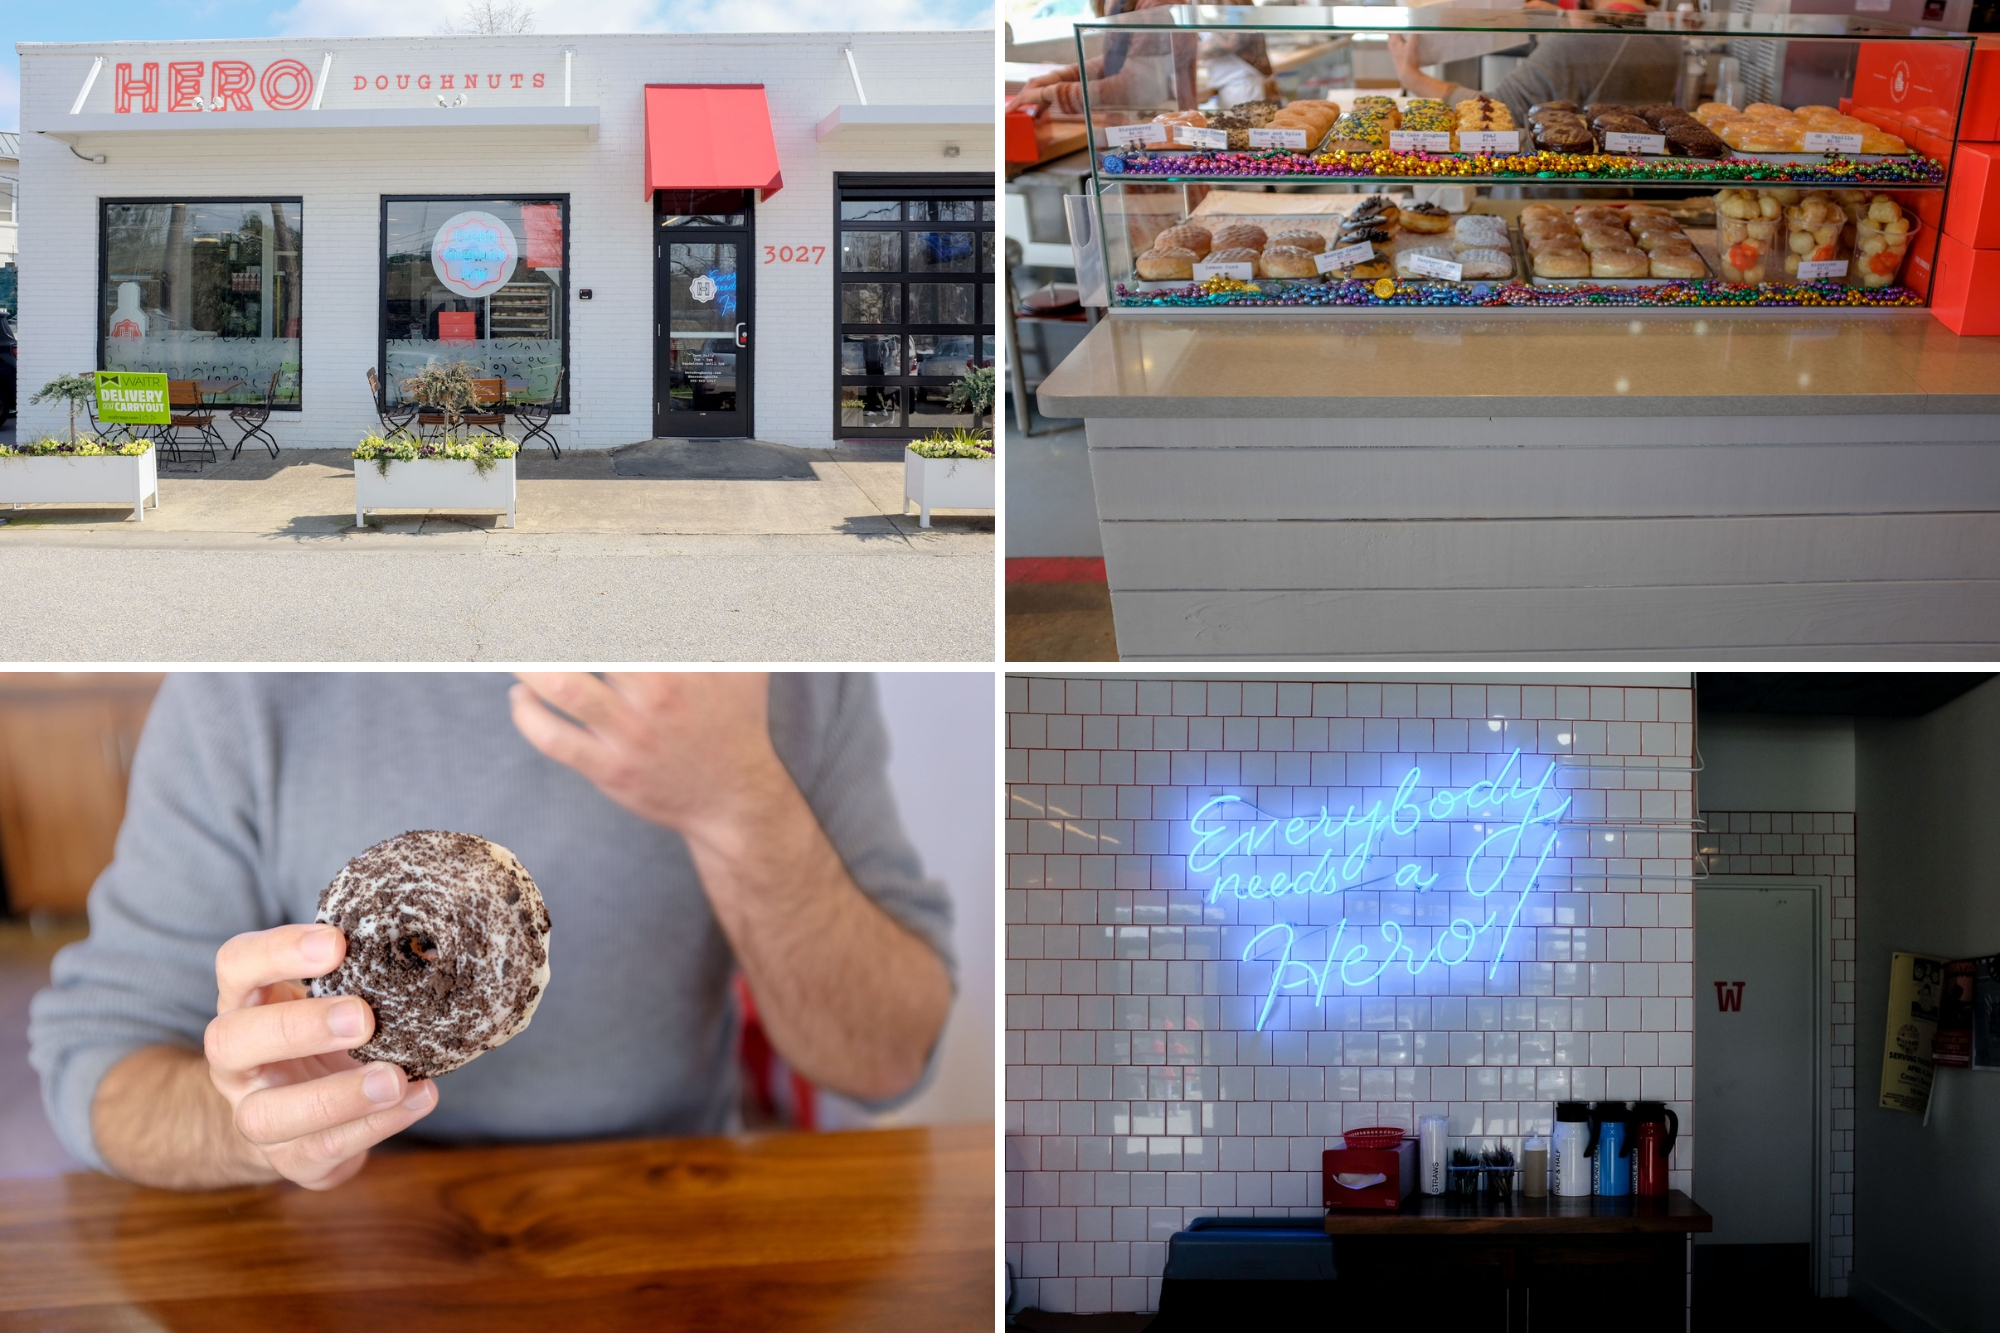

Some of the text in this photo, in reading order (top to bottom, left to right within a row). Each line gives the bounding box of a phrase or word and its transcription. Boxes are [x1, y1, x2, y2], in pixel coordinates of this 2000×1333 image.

[115, 58, 545, 113] HERO DOUGHNUTS
[455, 229, 496, 242] fresh
[764, 245, 826, 265] 3027
[101, 389, 163, 403] DELIVERY
[115, 402, 164, 413] CARRYOUT
[1189, 748, 1572, 897] Everybody
[1210, 849, 1439, 904] needs a
[1714, 981, 1746, 1012] W
[1431, 1161, 1440, 1193] STRAWS
